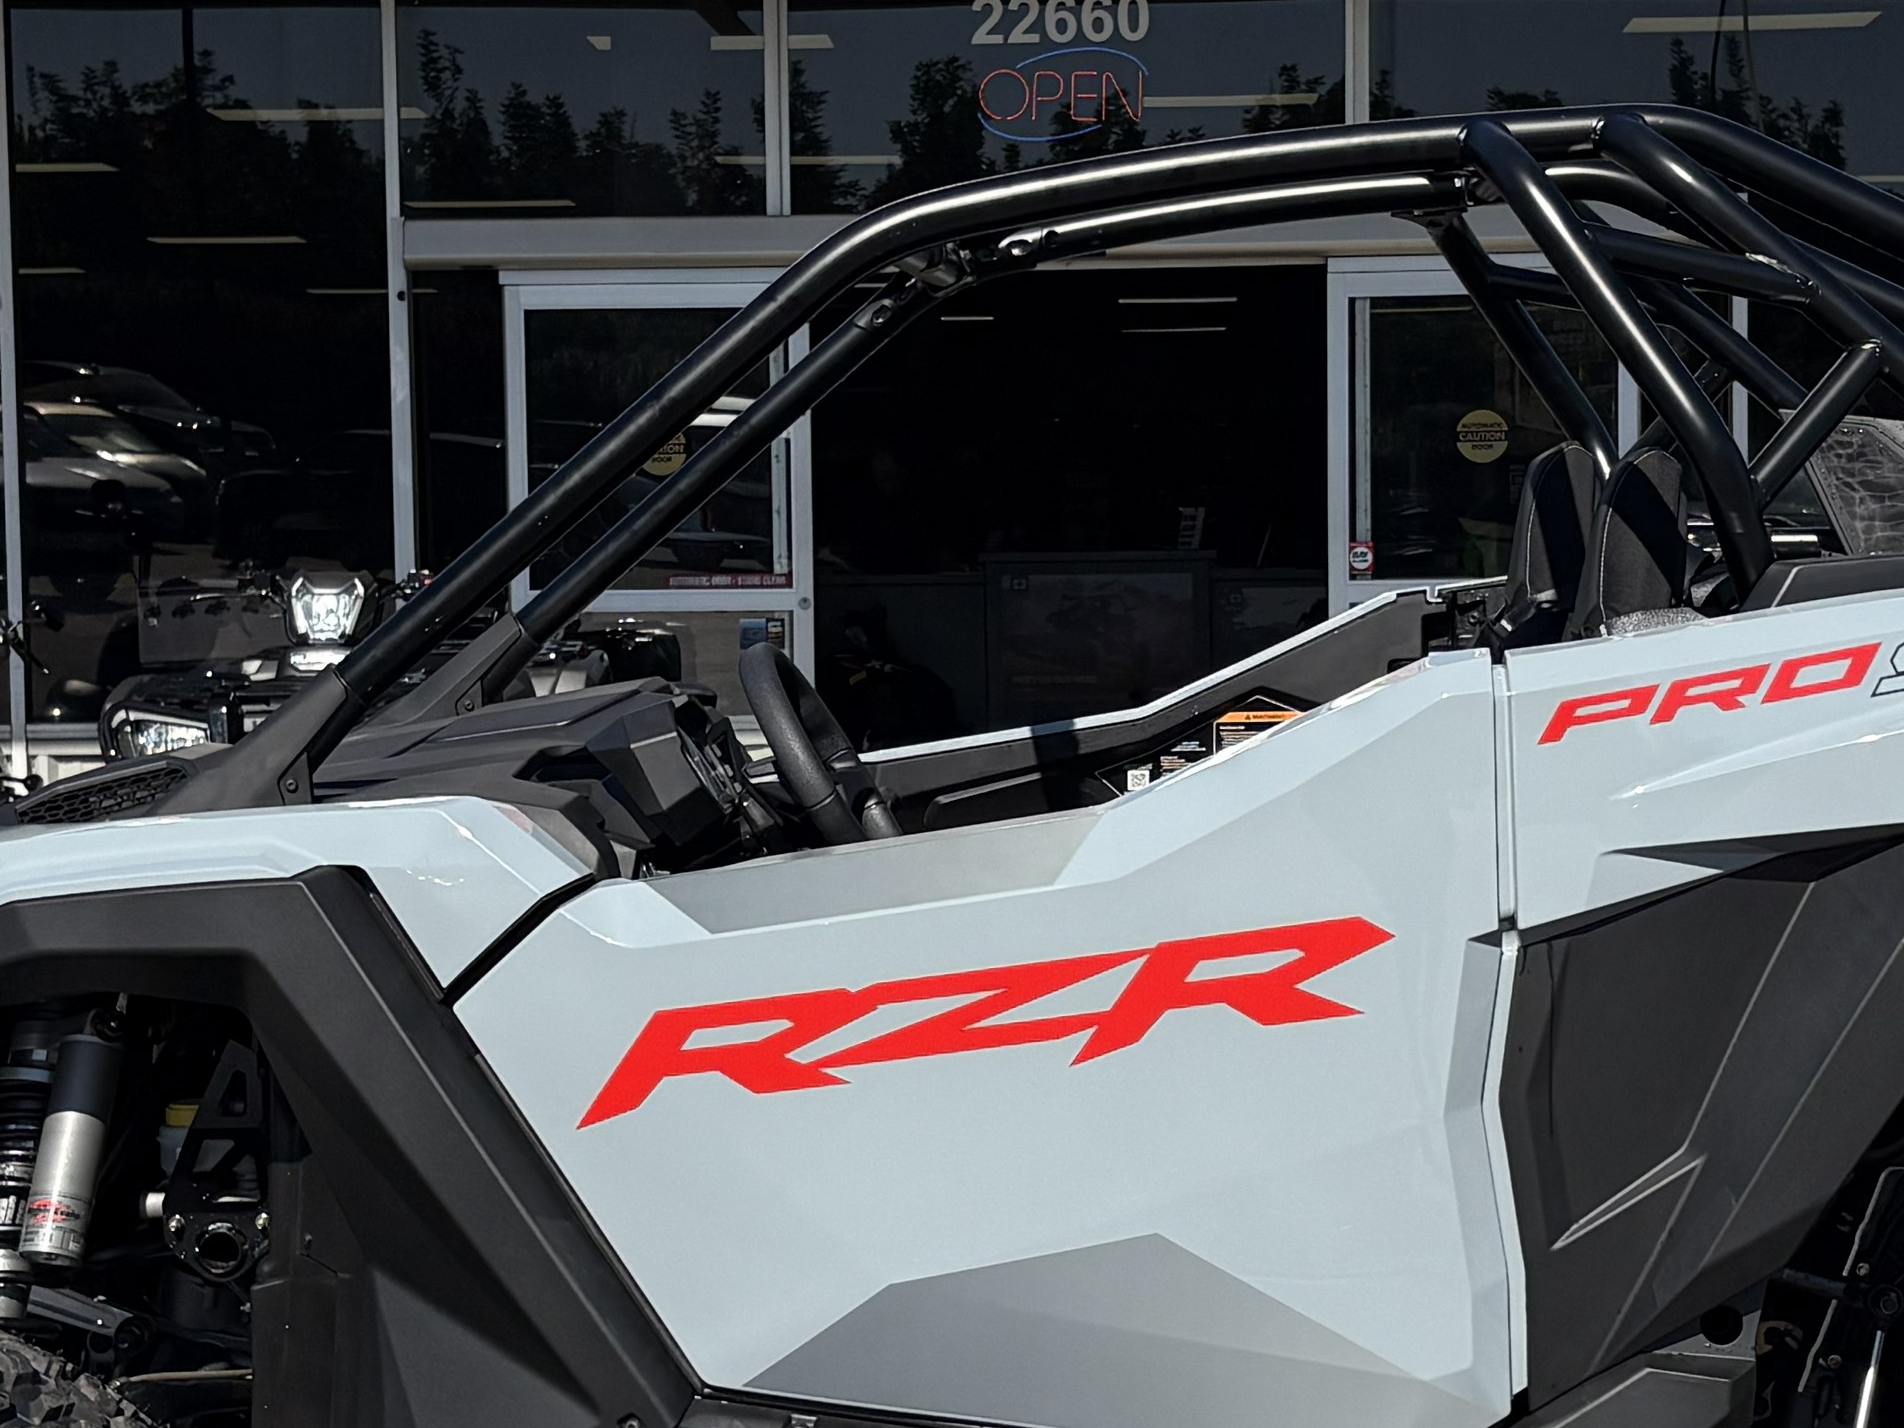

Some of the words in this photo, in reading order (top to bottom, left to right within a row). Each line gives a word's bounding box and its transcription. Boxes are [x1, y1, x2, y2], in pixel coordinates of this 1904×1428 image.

[978, 69, 1144, 123] OPEN
[1458, 431, 1506, 442] CAUTION
[1537, 642, 1883, 746] PRO
[575, 916, 1396, 1131] RZR
